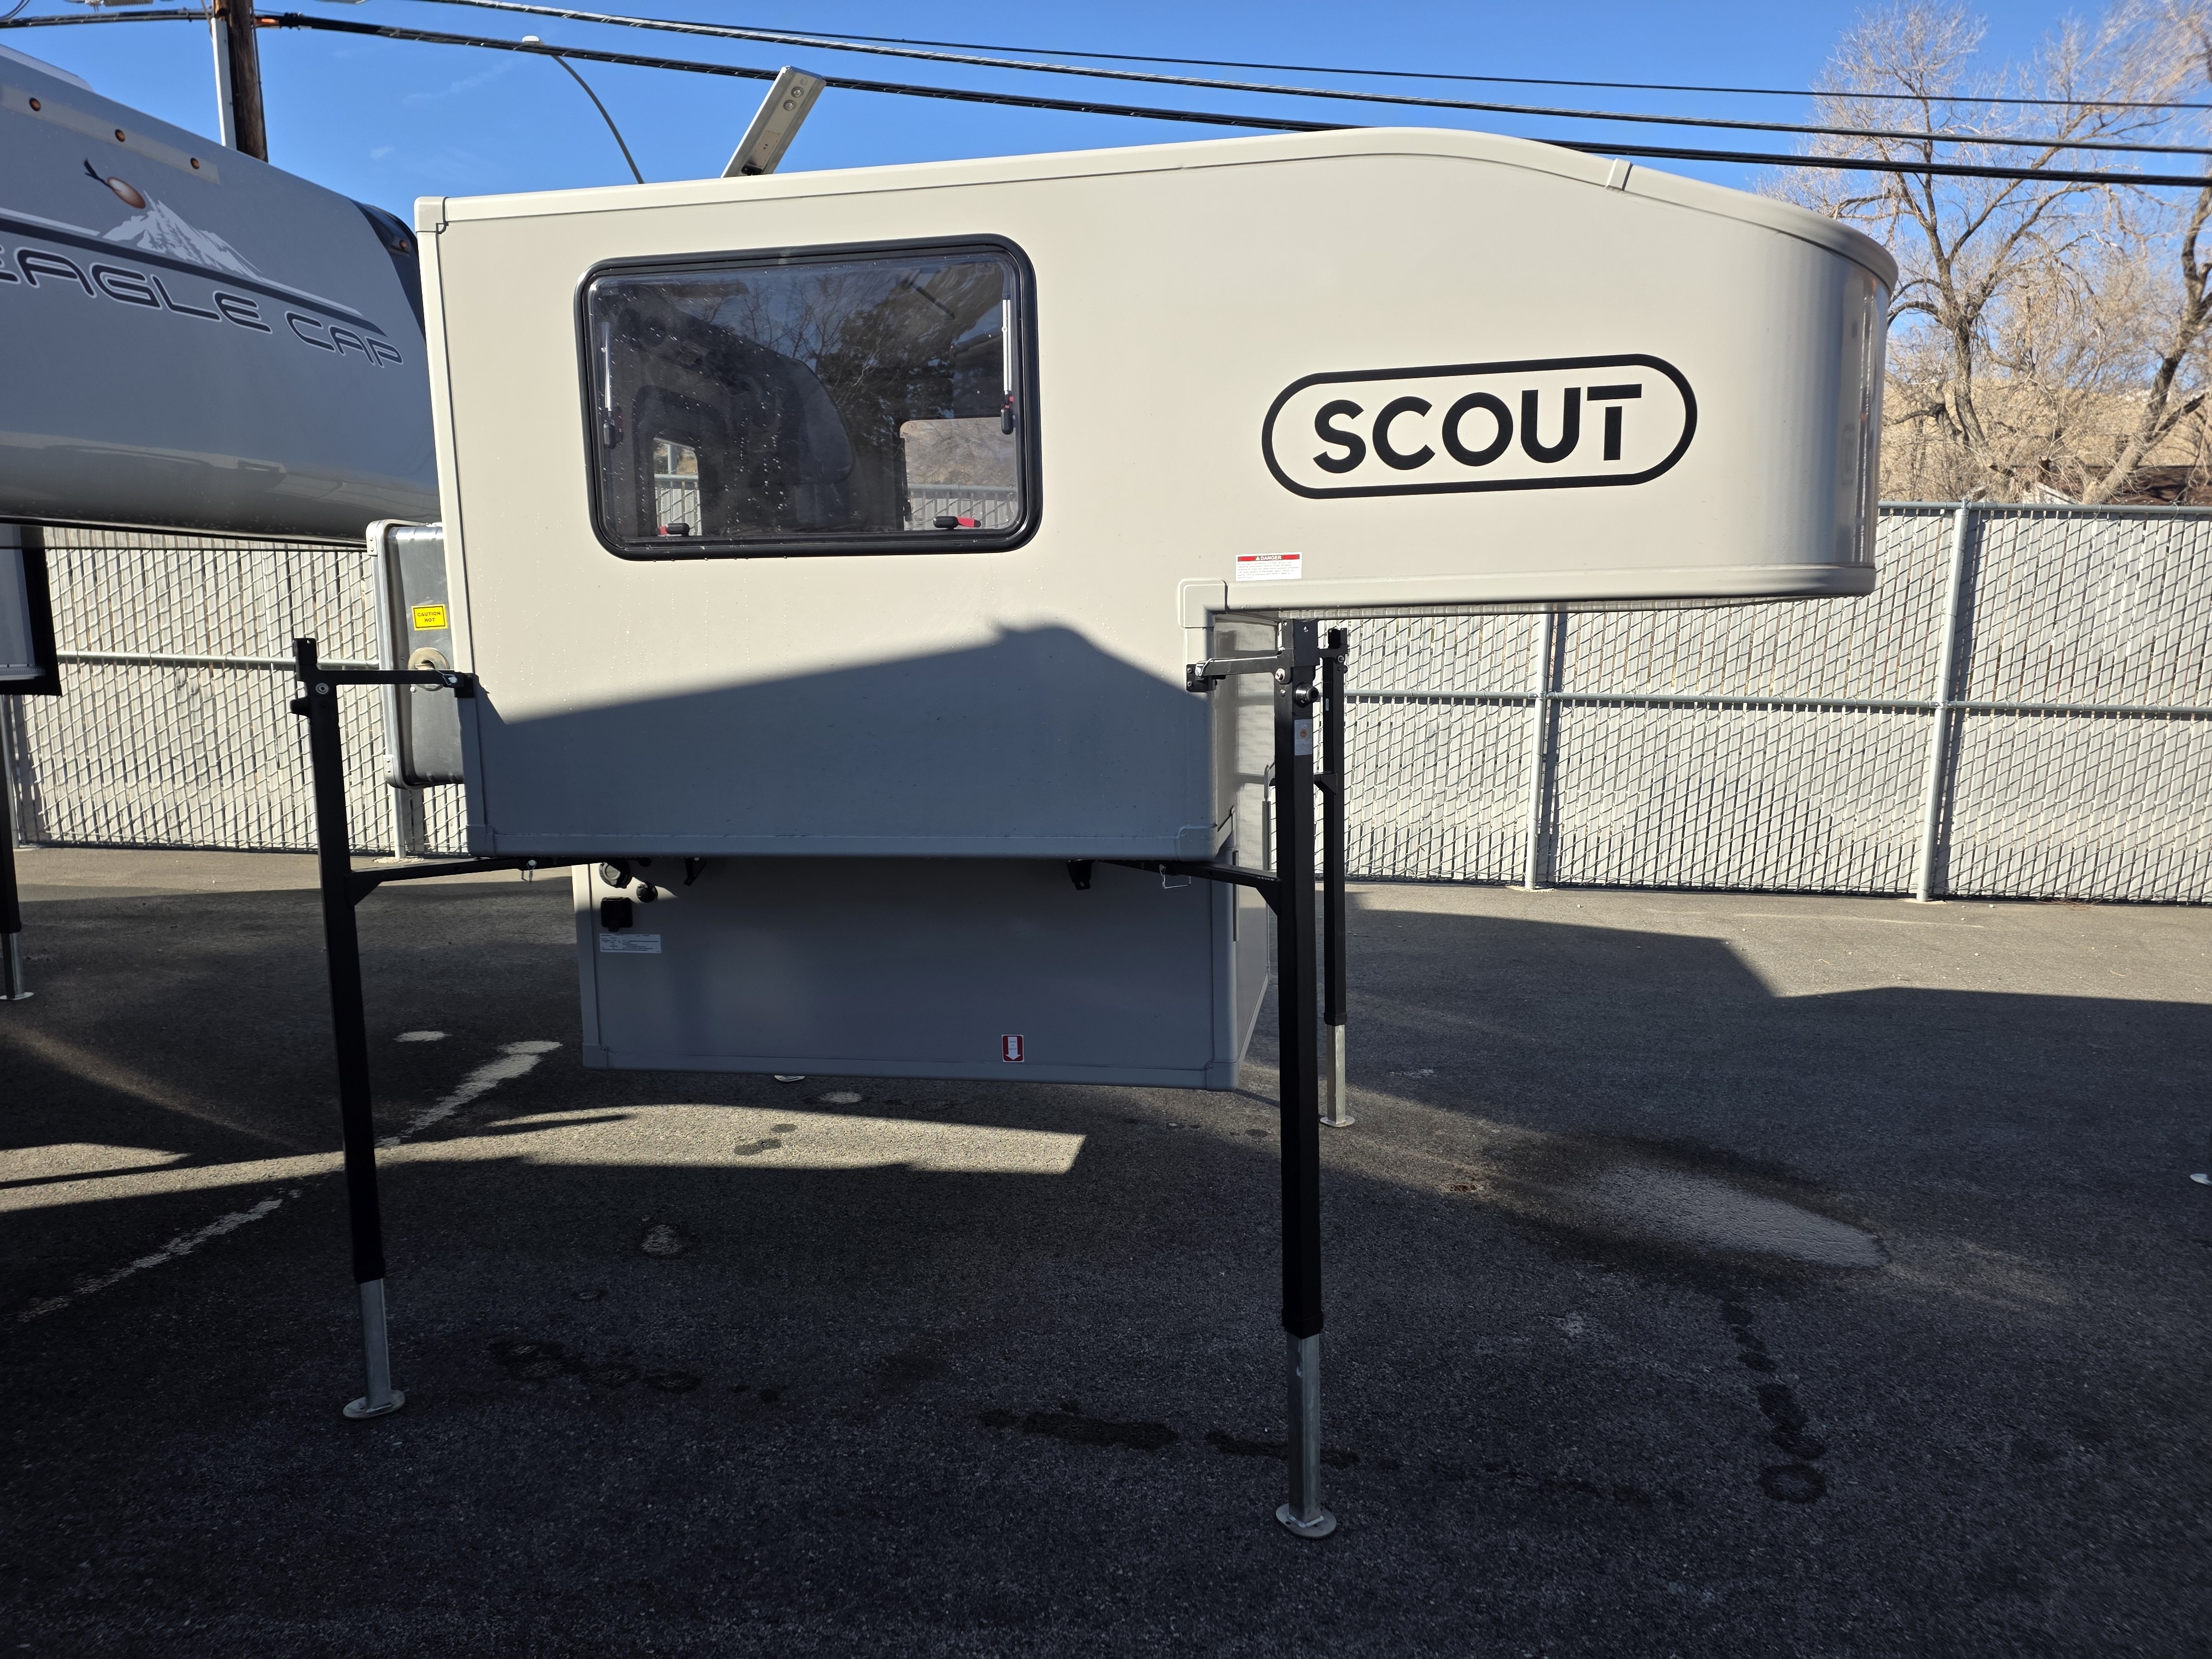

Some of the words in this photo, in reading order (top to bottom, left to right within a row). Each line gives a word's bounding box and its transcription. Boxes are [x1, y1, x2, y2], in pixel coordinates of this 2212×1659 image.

[0, 244, 273, 334] AGLE
[285, 310, 404, 368] CAP
[1313, 384, 1642, 473] SCOUT
